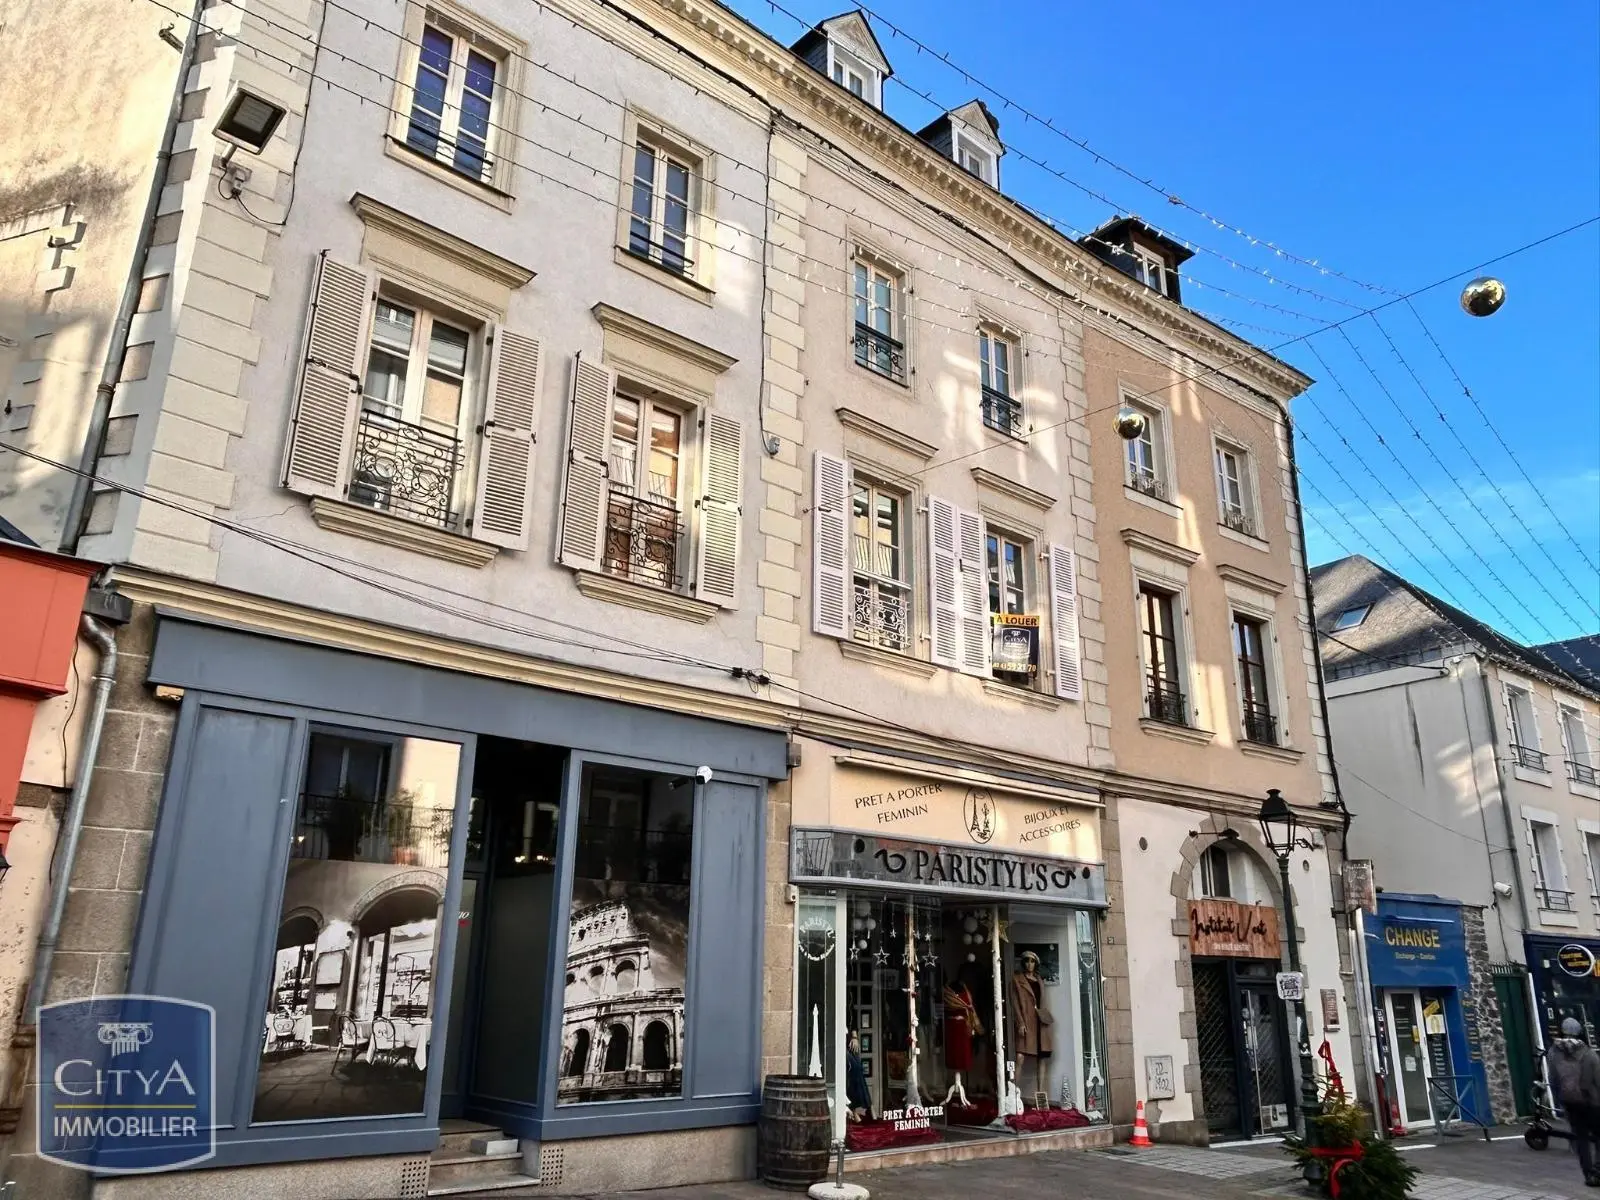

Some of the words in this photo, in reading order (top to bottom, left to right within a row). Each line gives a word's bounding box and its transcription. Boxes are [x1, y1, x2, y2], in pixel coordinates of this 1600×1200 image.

[1006, 617, 1037, 625] LOUER
[854, 793, 884, 808] PRET
[886, 792, 895, 802] A
[897, 783, 943, 800] PORTER
[877, 804, 928, 824] FEMININ
[1024, 808, 1058, 824] BIJOUX
[1060, 805, 1070, 815] ET
[1019, 818, 1081, 844] ACCESSOIRES
[914, 849, 1049, 892] PARISTYL'S
[1385, 925, 1441, 948] CHANGE
[883, 1109, 903, 1120] PRET
[914, 1106, 943, 1117] PORTER
[894, 1117, 930, 1131] FEMININ
